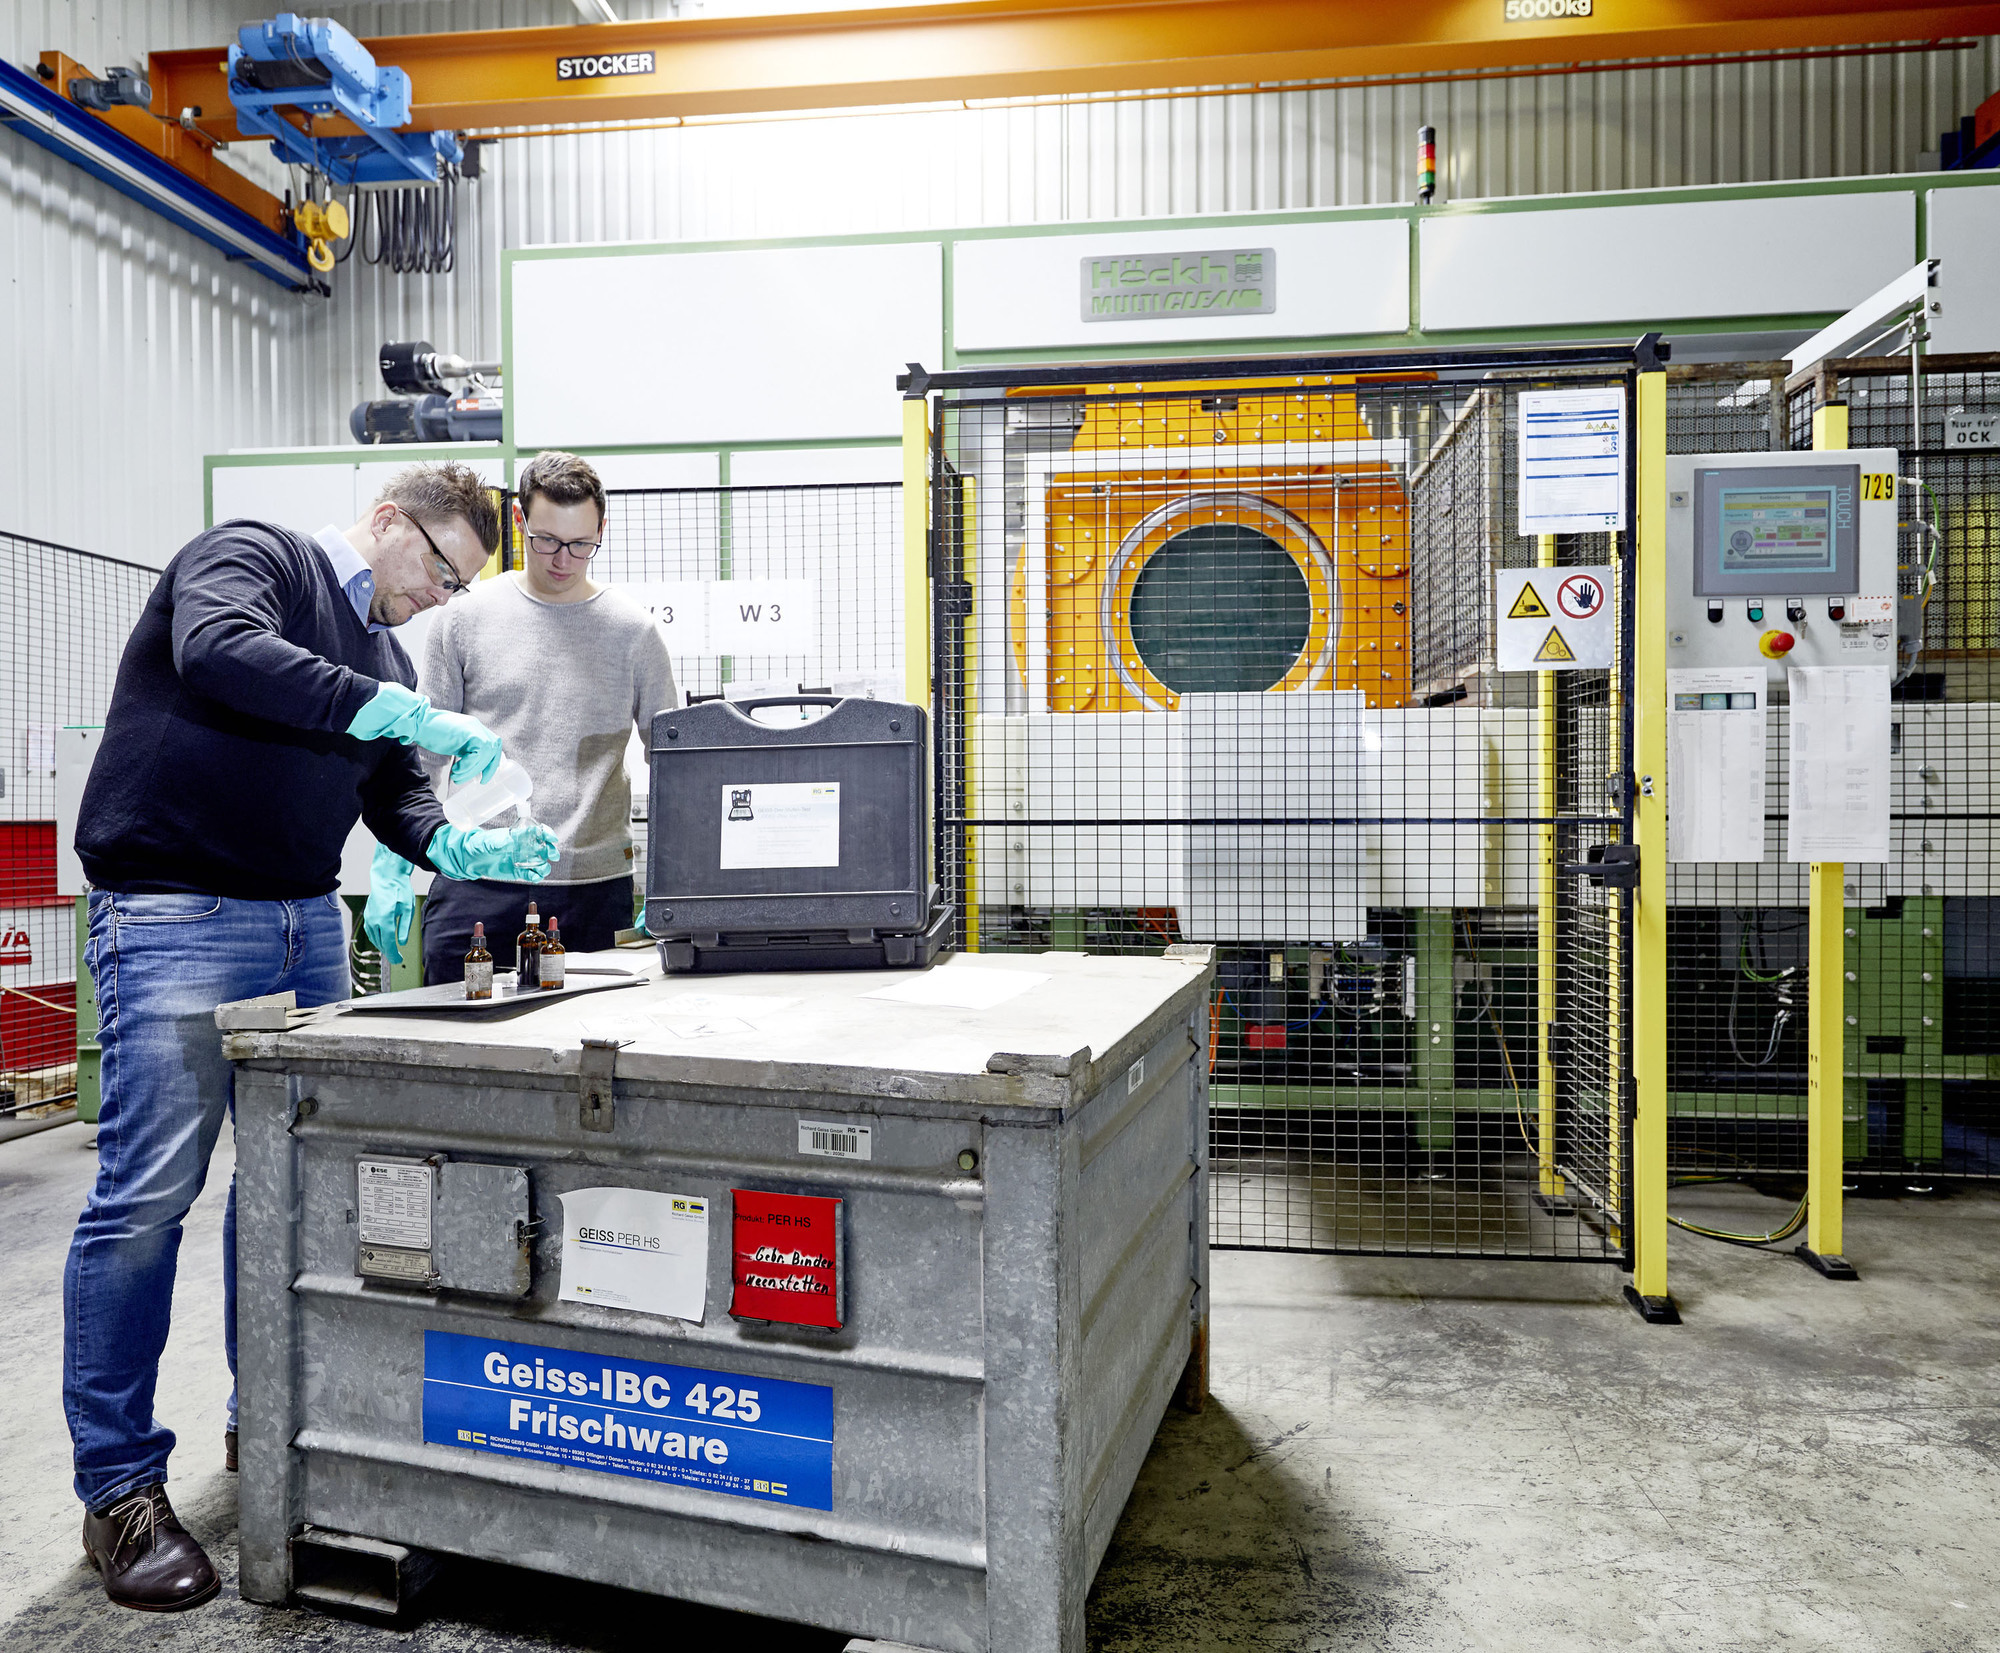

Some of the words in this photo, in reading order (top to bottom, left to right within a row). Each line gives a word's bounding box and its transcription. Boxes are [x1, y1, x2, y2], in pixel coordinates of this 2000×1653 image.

[1505, 0, 1592, 20] 5000kg
[558, 53, 653, 78] STOCKER
[1092, 256, 1229, 290] Höckh
[1837, 485, 1851, 529] TOUCH
[739, 604, 762, 622] W
[769, 604, 782, 622] 3
[673, 1201, 686, 1210] RG
[734, 1212, 765, 1224] Produkt:
[767, 1213, 791, 1226] PER
[794, 1216, 812, 1228] HS
[579, 1226, 615, 1243] GEISS
[617, 1232, 641, 1246] PER
[643, 1236, 661, 1250] HS
[483, 1351, 672, 1409] Geiss-IBC
[684, 1382, 762, 1422] 425
[508, 1398, 729, 1465] Frischware
[490, 1435, 511, 1444] RICHARD
[511, 1438, 525, 1446] GEISS
[585, 1451, 606, 1460] Offingen
[608, 1455, 624, 1463] Donau
[490, 1441, 522, 1452] Niederlassung:
[523, 1447, 545, 1455] Brüsseler
[545, 1450, 560, 1458] Straße
[586, 1457, 607, 1466] Troisdorf
[612, 1462, 630, 1470] Telefon:
[755, 1481, 768, 1491] RG
